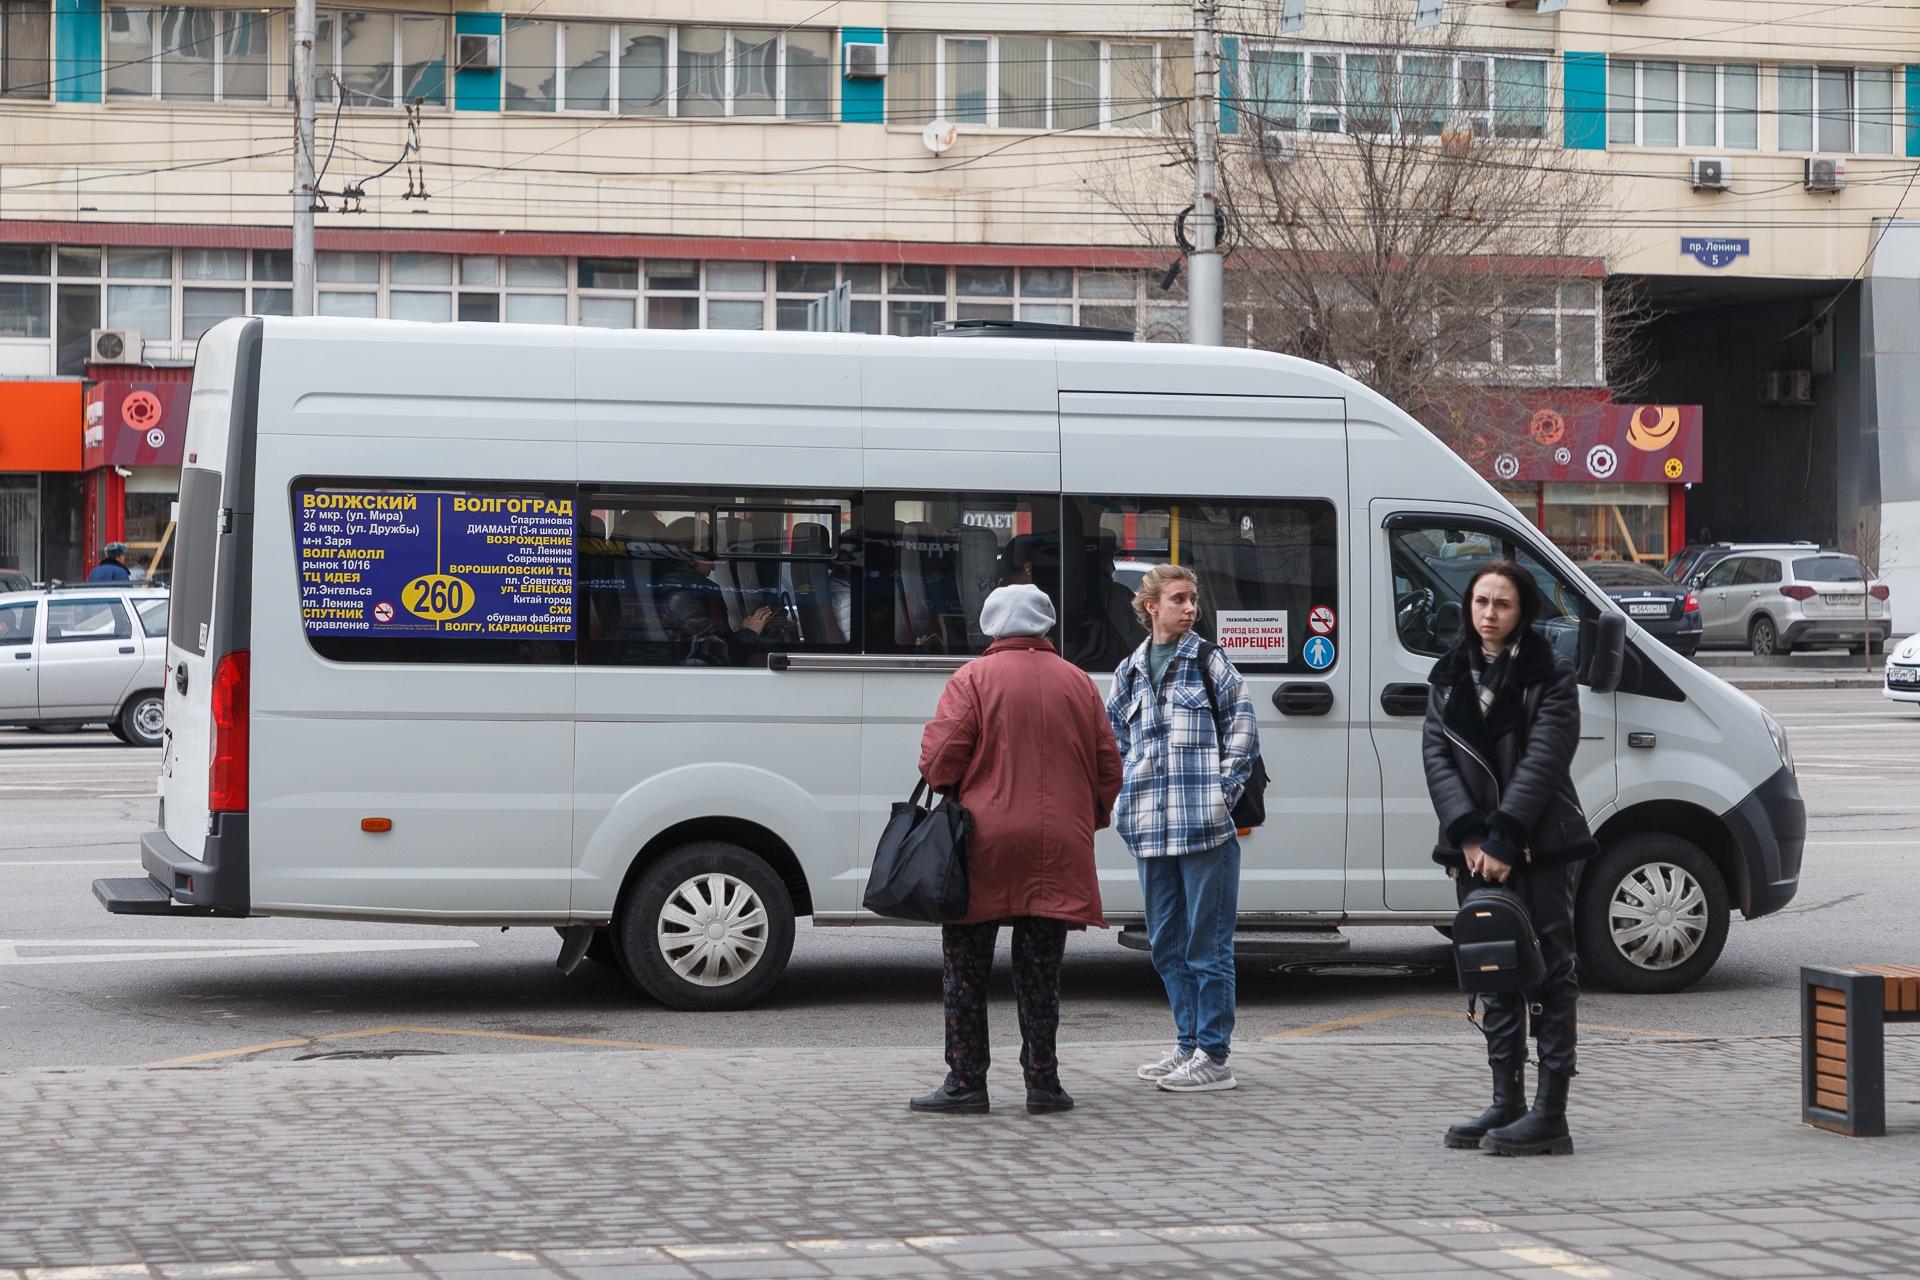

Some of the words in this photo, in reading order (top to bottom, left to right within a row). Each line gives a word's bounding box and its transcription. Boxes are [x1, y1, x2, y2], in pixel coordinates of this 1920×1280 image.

[1689, 243, 1704, 252] пр.
[1706, 241, 1741, 252] Ленина
[1712, 254, 1719, 266] 5
[303, 493, 417, 510] ВОЛЖСКИЙ
[453, 497, 572, 516] ВОЛГОГРАД
[303, 509, 316, 519] 37
[319, 511, 343, 521] мкр.
[346, 510, 367, 522] (ул.
[369, 511, 403, 522] Мира)
[510, 515, 572, 525] Спартановка
[303, 522, 316, 532] 26
[319, 524, 343, 533] мкр.
[346, 523, 367, 534] (ул.
[369, 523, 420, 536] Дружбы)
[467, 525, 517, 534] ДИАМАНТ
[519, 526, 537, 536] (3-я
[540, 527, 572, 537] школа)
[325, 536, 352, 547] Заря
[486, 535, 573, 546] ВОЗРОЖДЕНИЕ
[303, 548, 385, 559] ВОЛГАМОЛЛ
[520, 547, 534, 555] пл.
[537, 546, 572, 555] Ленина
[507, 554, 572, 564] Современник
[303, 561, 338, 571] рынок
[342, 560, 371, 570] 10/16
[449, 564, 554, 575] ВОРОШИЛОВСКИЙ
[556, 566, 572, 577] ТЦ
[303, 572, 321, 583] ТЦ
[324, 572, 360, 583] ИДЕЯ
[505, 577, 520, 585] пл.
[522, 576, 572, 586] Советская
[303, 585, 373, 597] ул.Энгельса
[500, 585, 517, 594] ул.
[520, 584, 572, 595] ЕЛЕЦКАЯ
[413, 579, 464, 614] 260
[513, 595, 541, 604] Китай
[544, 597, 572, 605] город
[302, 599, 319, 608] пл.
[322, 598, 364, 608] Ленина
[303, 609, 363, 619] СПУТНИК
[549, 605, 572, 614] СХИ
[486, 613, 527, 623] обувная
[529, 613, 572, 623] фабрика
[304, 620, 370, 631] Управление
[445, 622, 485, 633] ВОЛГУ,
[488, 624, 572, 634] КАРДИОЦЕНТР
[1221, 637, 1285, 649] ЗАПРЕЩЕН!
